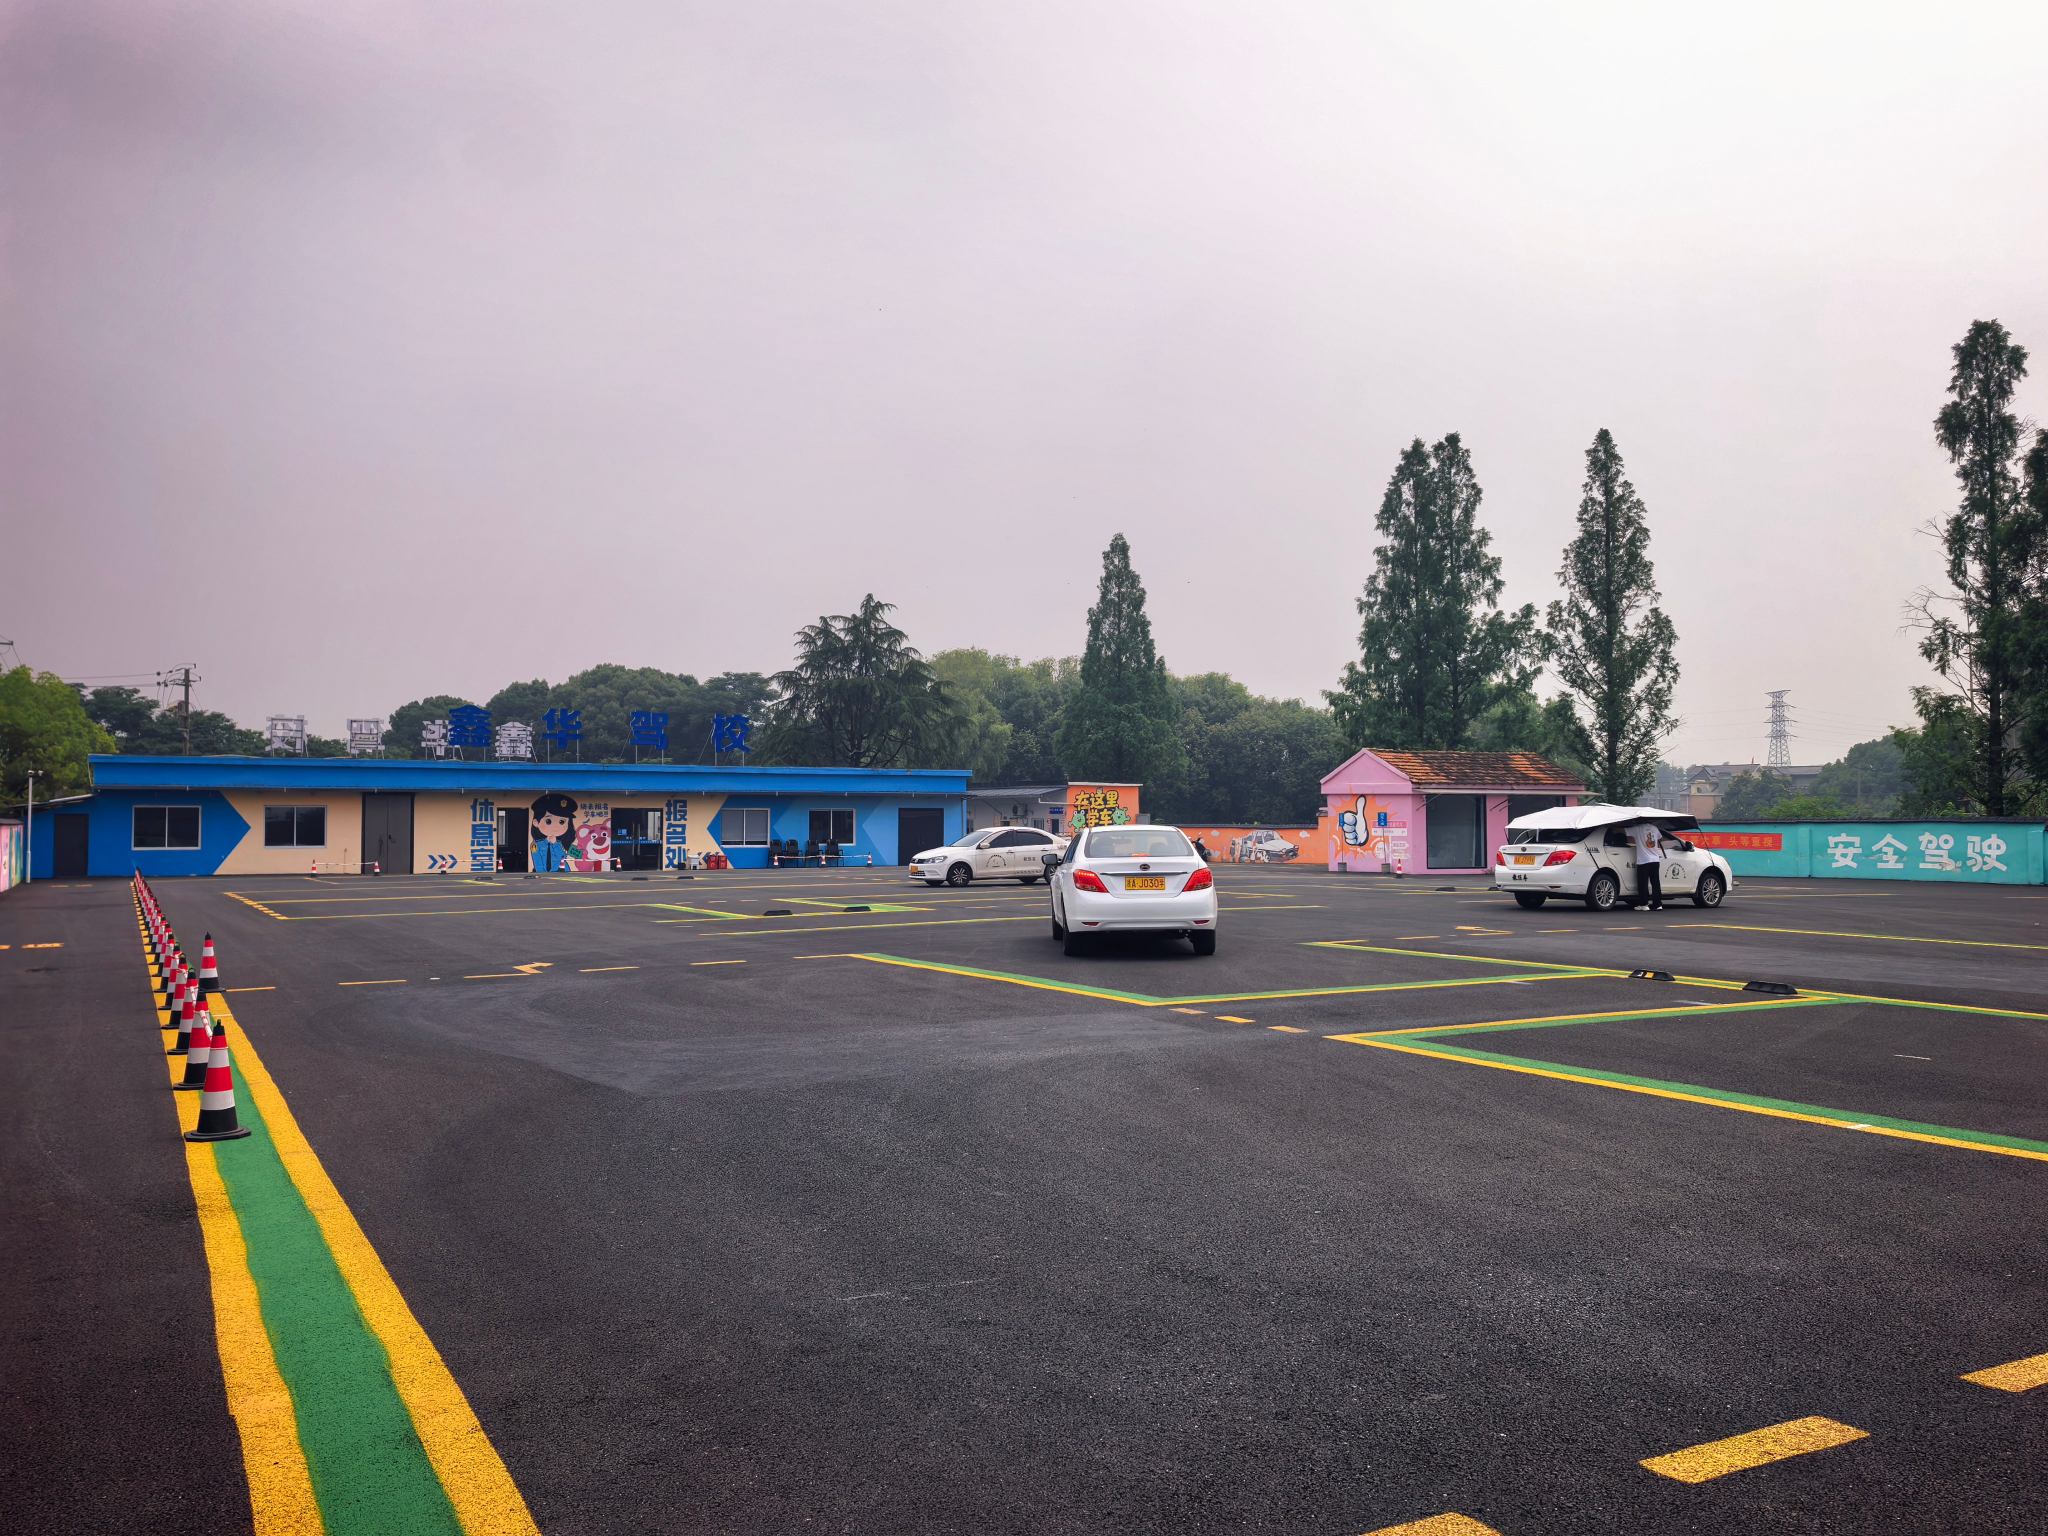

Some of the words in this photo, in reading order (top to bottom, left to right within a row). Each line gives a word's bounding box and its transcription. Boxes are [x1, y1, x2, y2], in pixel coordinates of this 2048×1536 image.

[449, 704, 751, 752] 鑫华驾校
[1074, 791, 1119, 810] 在这里
[1087, 809, 1112, 826] 学车
[470, 798, 494, 872] 休息室
[666, 800, 687, 869] 报名处
[1827, 832, 2008, 872] 安全驾驶
